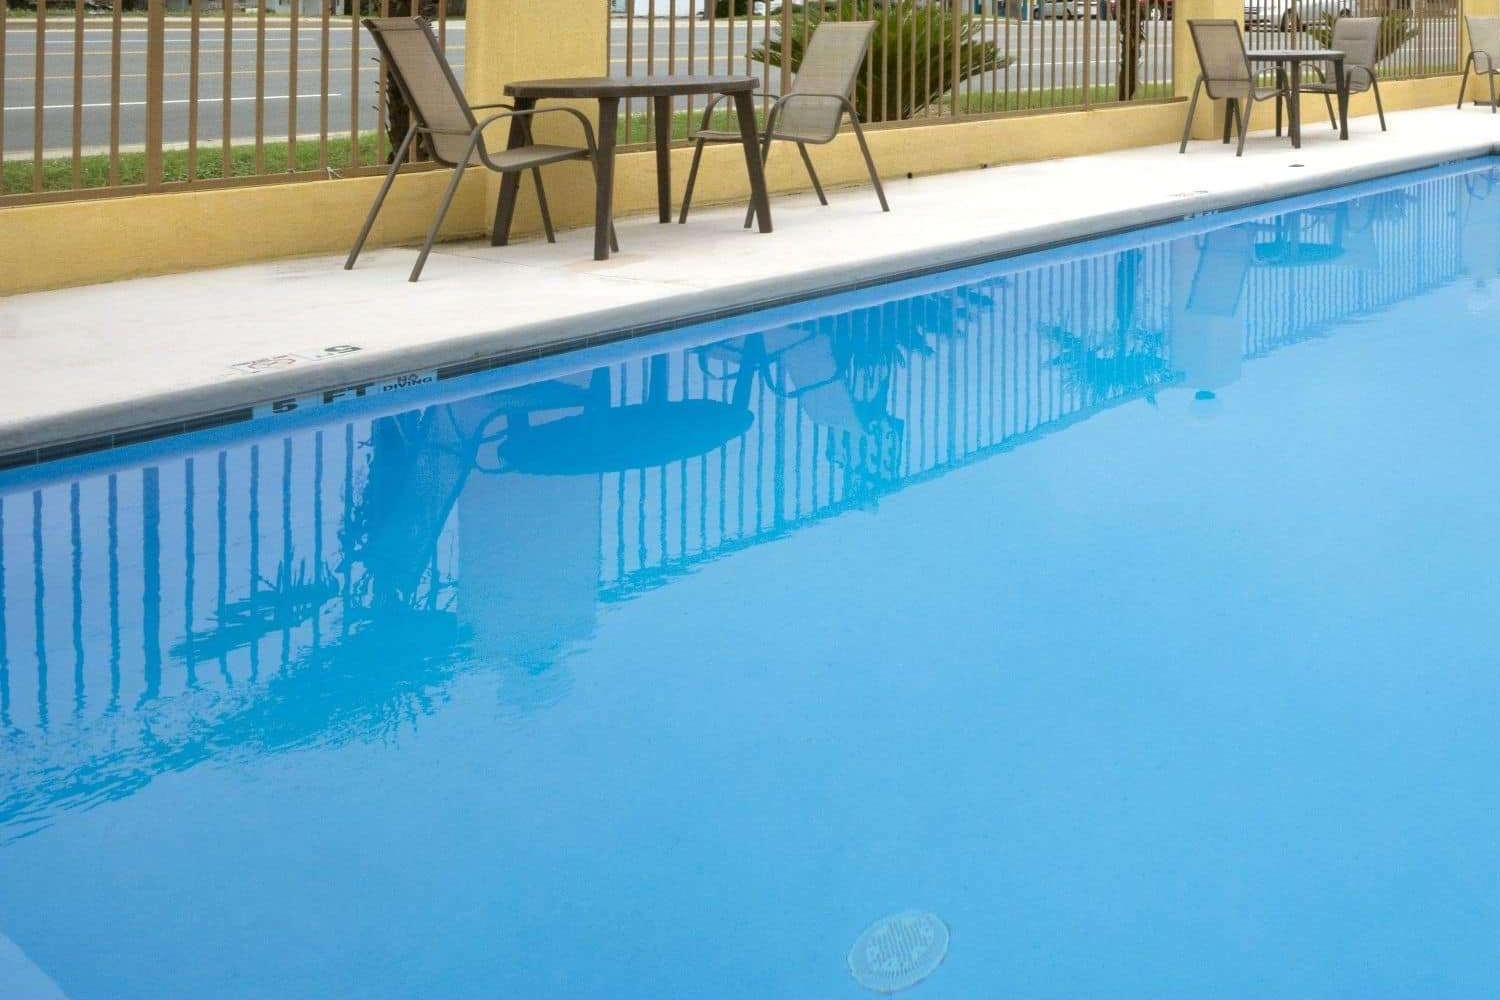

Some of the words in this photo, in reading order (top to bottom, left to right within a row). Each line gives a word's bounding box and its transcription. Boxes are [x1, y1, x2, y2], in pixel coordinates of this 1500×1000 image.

[383, 376, 433, 392] DIVING
[272, 398, 298, 413] 5
[323, 382, 376, 404] FT
